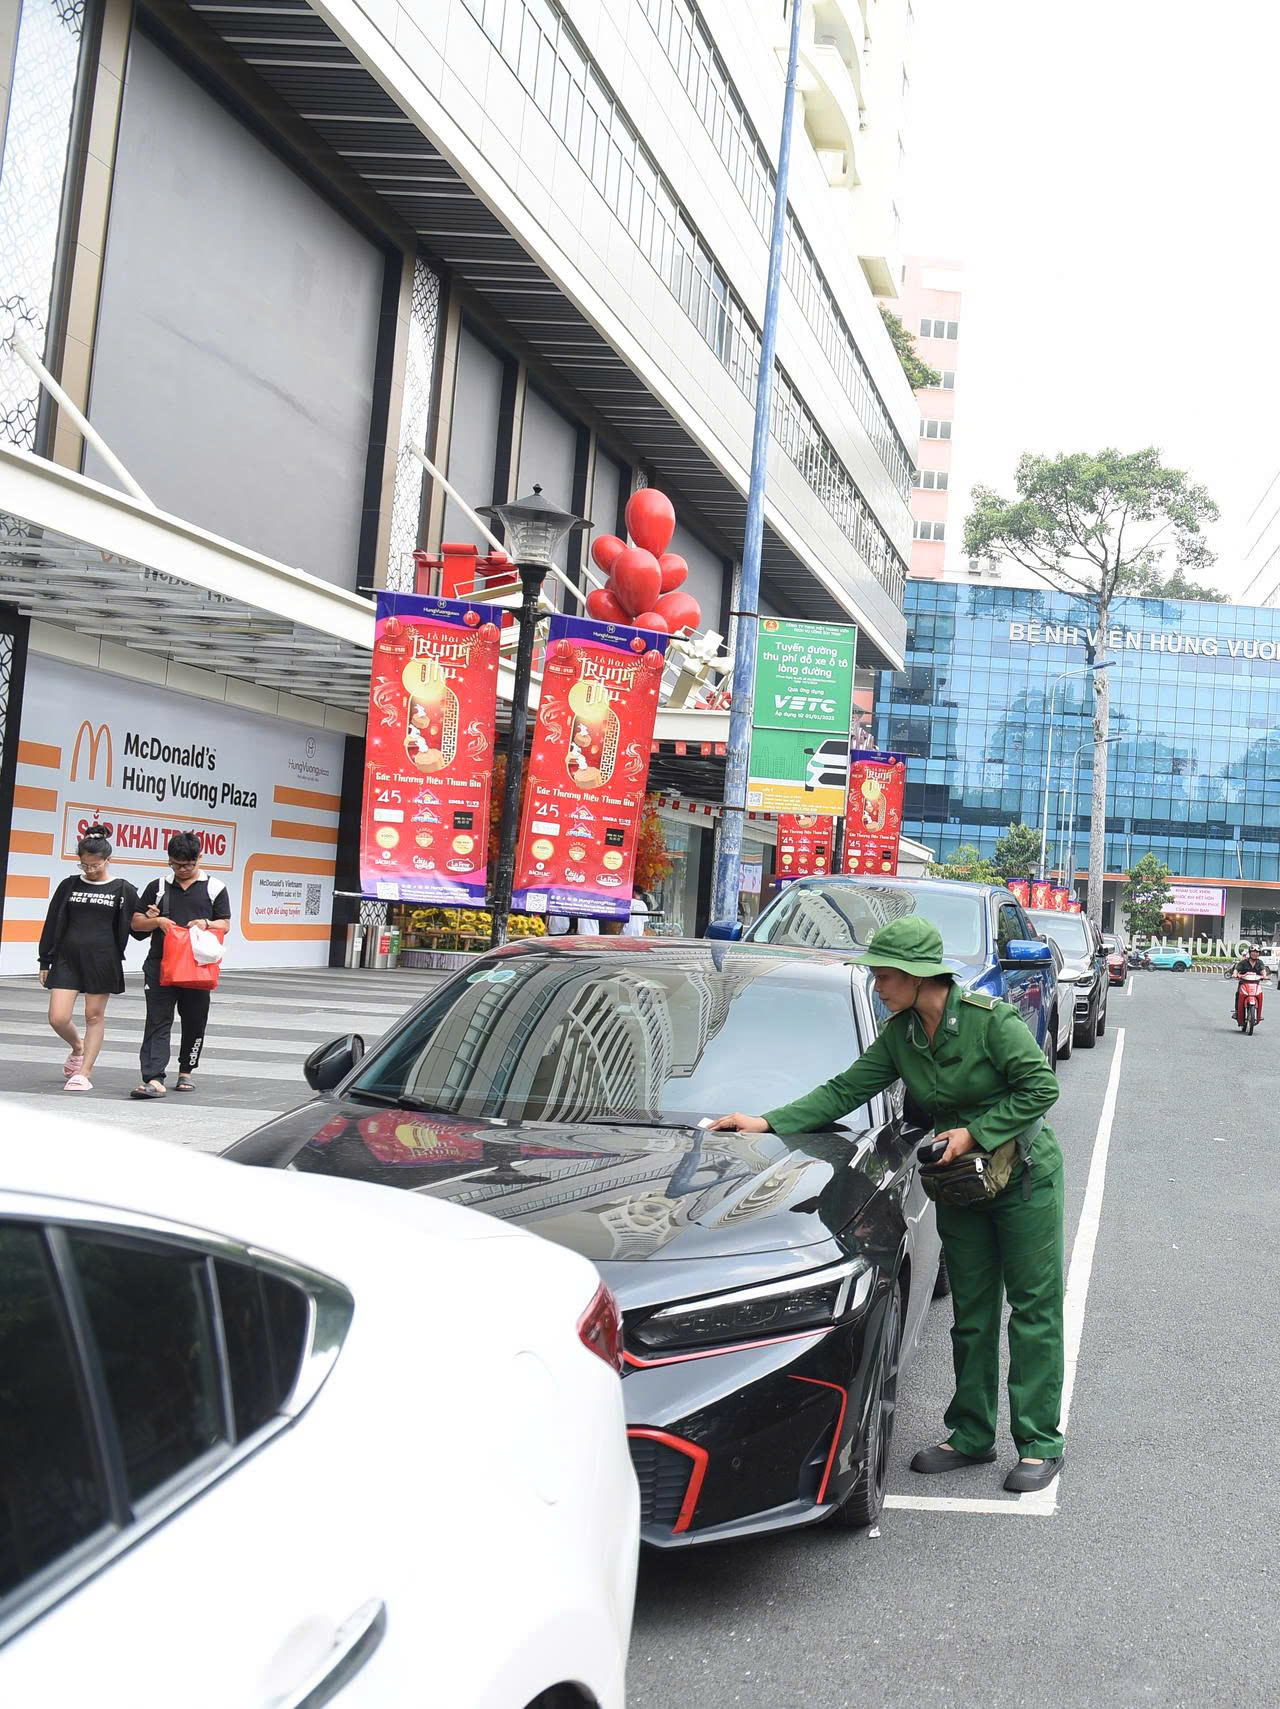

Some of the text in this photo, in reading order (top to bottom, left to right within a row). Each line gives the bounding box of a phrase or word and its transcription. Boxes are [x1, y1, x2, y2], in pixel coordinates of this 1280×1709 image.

[1009, 618, 1078, 647] BỆNH
[1087, 625, 1141, 653] VỆN
[1150, 630, 1218, 656] HÙNG
[775, 642, 837, 657] Tuyến đường
[763, 652, 779, 660] thu
[782, 654, 797, 664] phí
[800, 653, 812, 664] đỗ
[829, 658, 835, 666] ô
[838, 659, 848, 668] tô
[778, 664, 832, 678] lòng đường
[775, 694, 837, 713] VETC
[123, 732, 216, 771] McDonald's
[122, 766, 257, 809] Hùng Vương Plaza
[377, 789, 402, 804] 45
[536, 803, 560, 818] 45
[116, 823, 159, 850] KHAI
[285, 880, 302, 888] Vietnam
[71, 891, 116, 900] ESTERDAY
[90, 897, 115, 907] MORE
[189, 1037, 202, 1066] adidas
